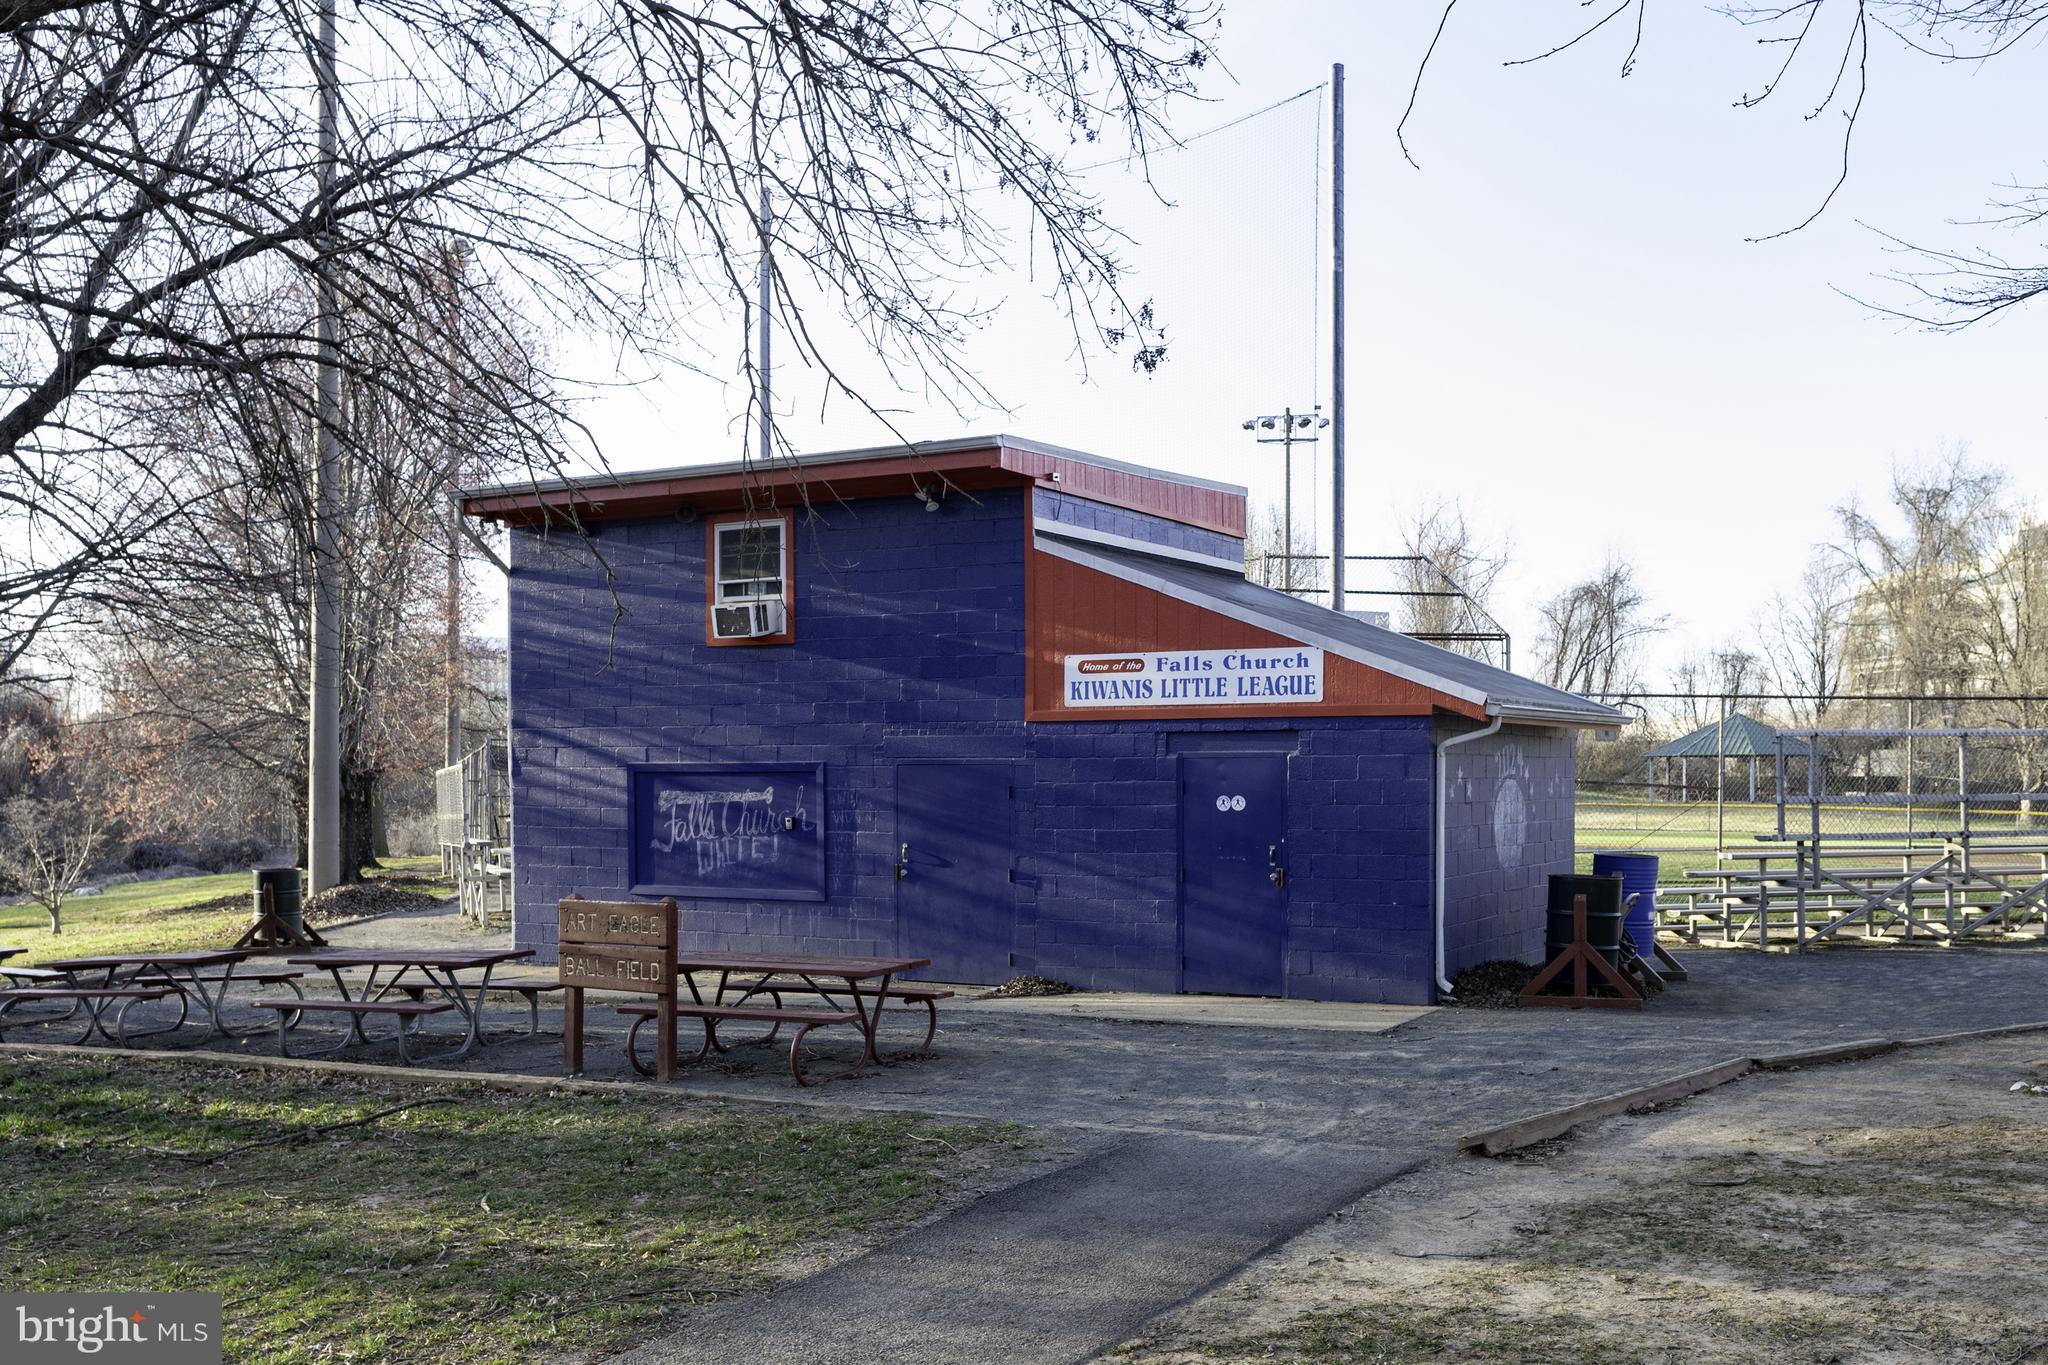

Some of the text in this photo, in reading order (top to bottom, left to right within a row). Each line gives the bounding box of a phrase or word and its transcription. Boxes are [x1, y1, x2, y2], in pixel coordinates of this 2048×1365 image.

[1082, 652, 1311, 672] Home of the Falls Church
[1070, 674, 1317, 701] KIWANIS LITTLE LEAGUE
[650, 784, 816, 853] Falls Church
[566, 913, 660, 935] ART EAGLE
[565, 957, 660, 981] BALL FIELD
